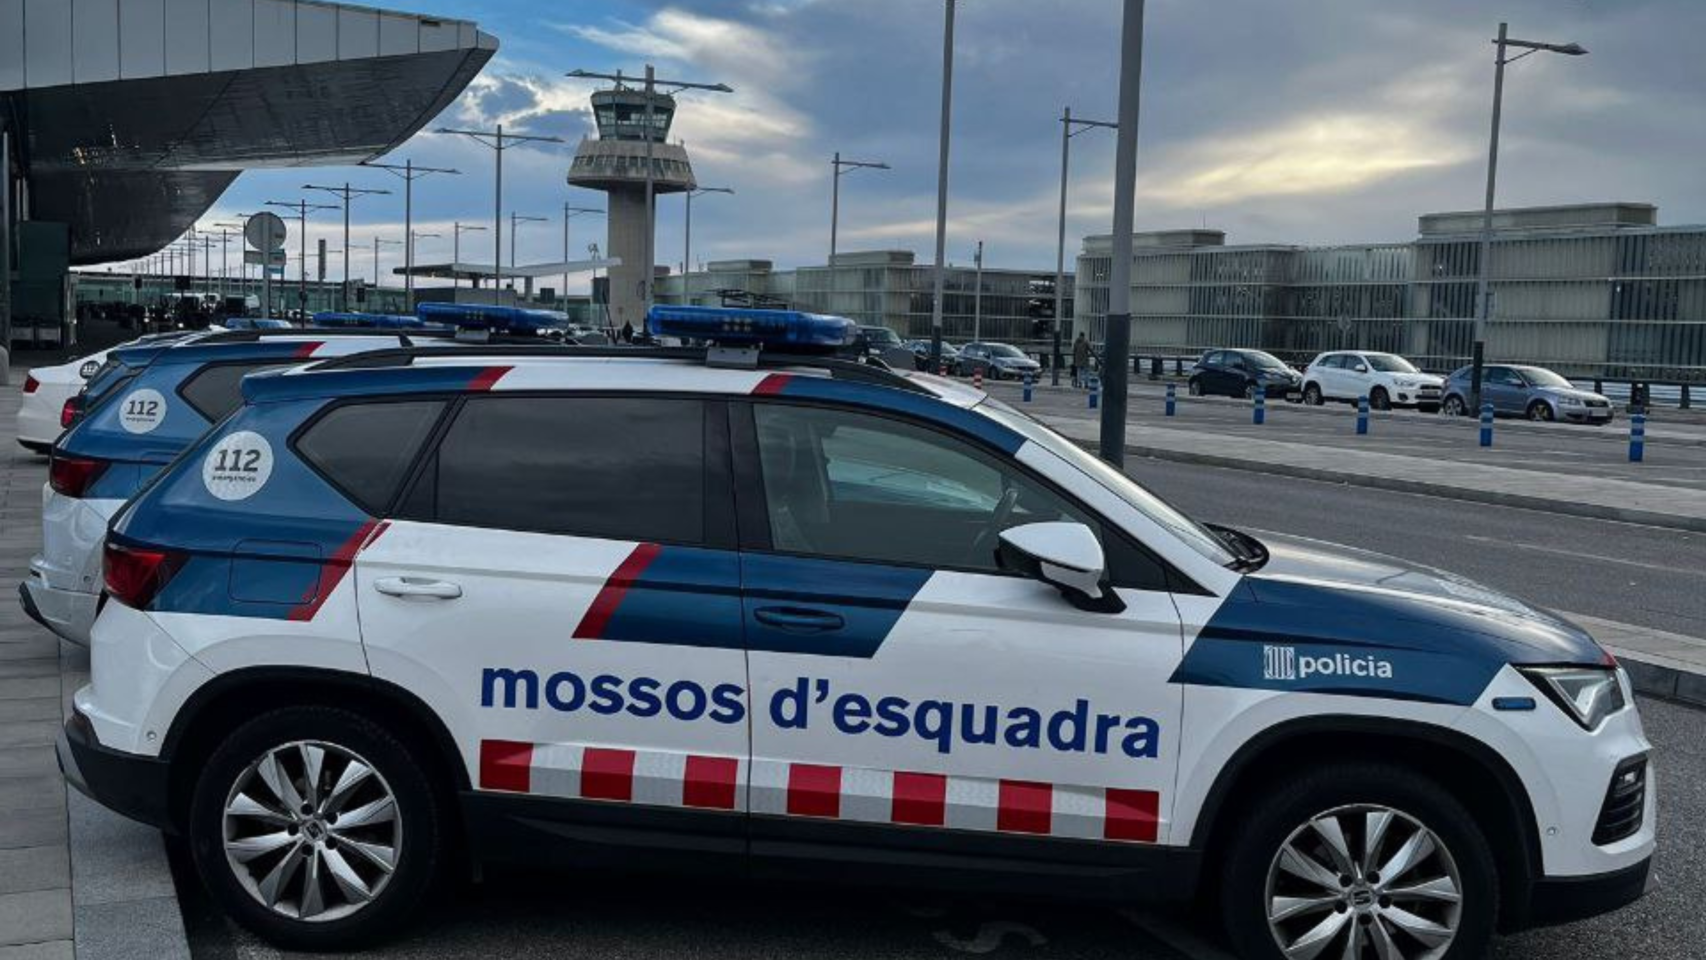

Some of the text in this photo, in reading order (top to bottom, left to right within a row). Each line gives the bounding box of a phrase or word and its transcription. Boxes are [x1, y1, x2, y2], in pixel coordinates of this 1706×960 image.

[127, 400, 158, 416] 112
[215, 449, 261, 472] 112
[1299, 653, 1393, 679] policia
[480, 667, 1160, 758] mossos d'esquadra
